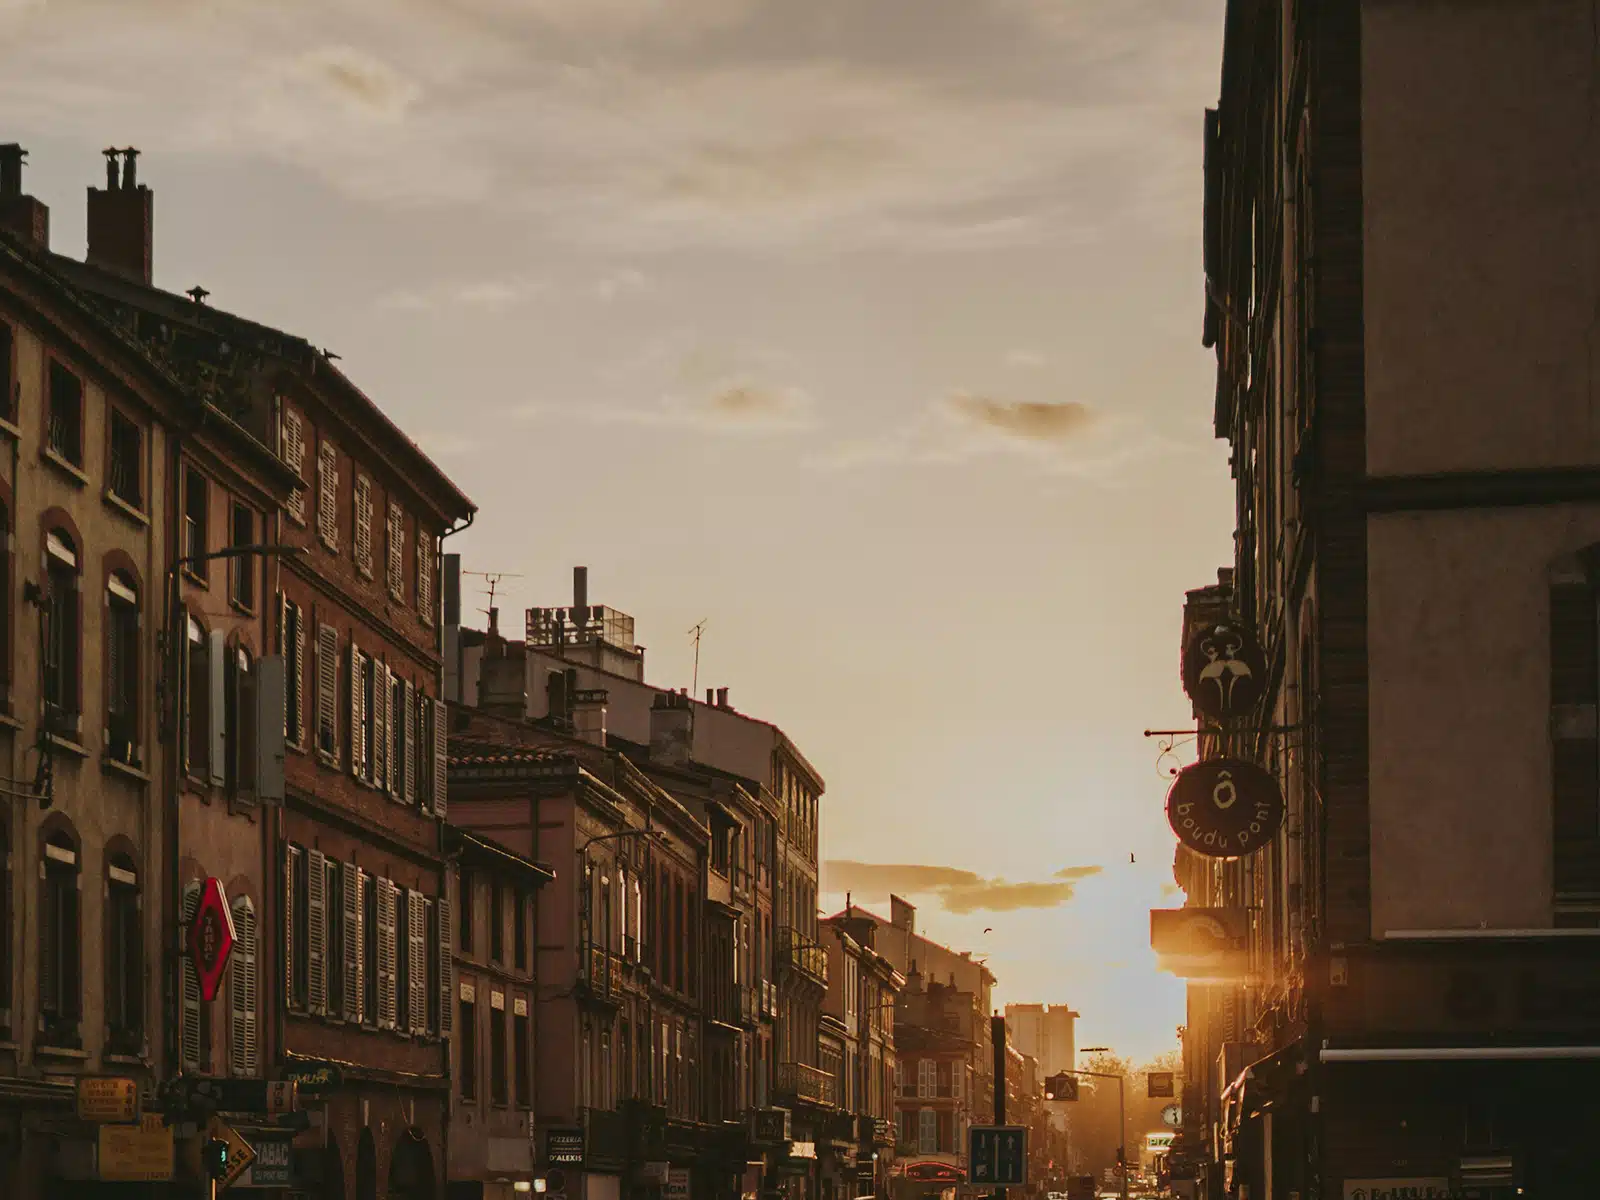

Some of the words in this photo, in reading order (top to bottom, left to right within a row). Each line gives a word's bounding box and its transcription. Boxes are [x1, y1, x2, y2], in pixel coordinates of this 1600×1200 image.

[1177, 801, 1227, 848] boudu
[1238, 801, 1271, 848] pont
[203, 916, 214, 961] TABAC
[256, 1143, 288, 1166] TABAC
[1150, 1138, 1174, 1146] PIZZ
